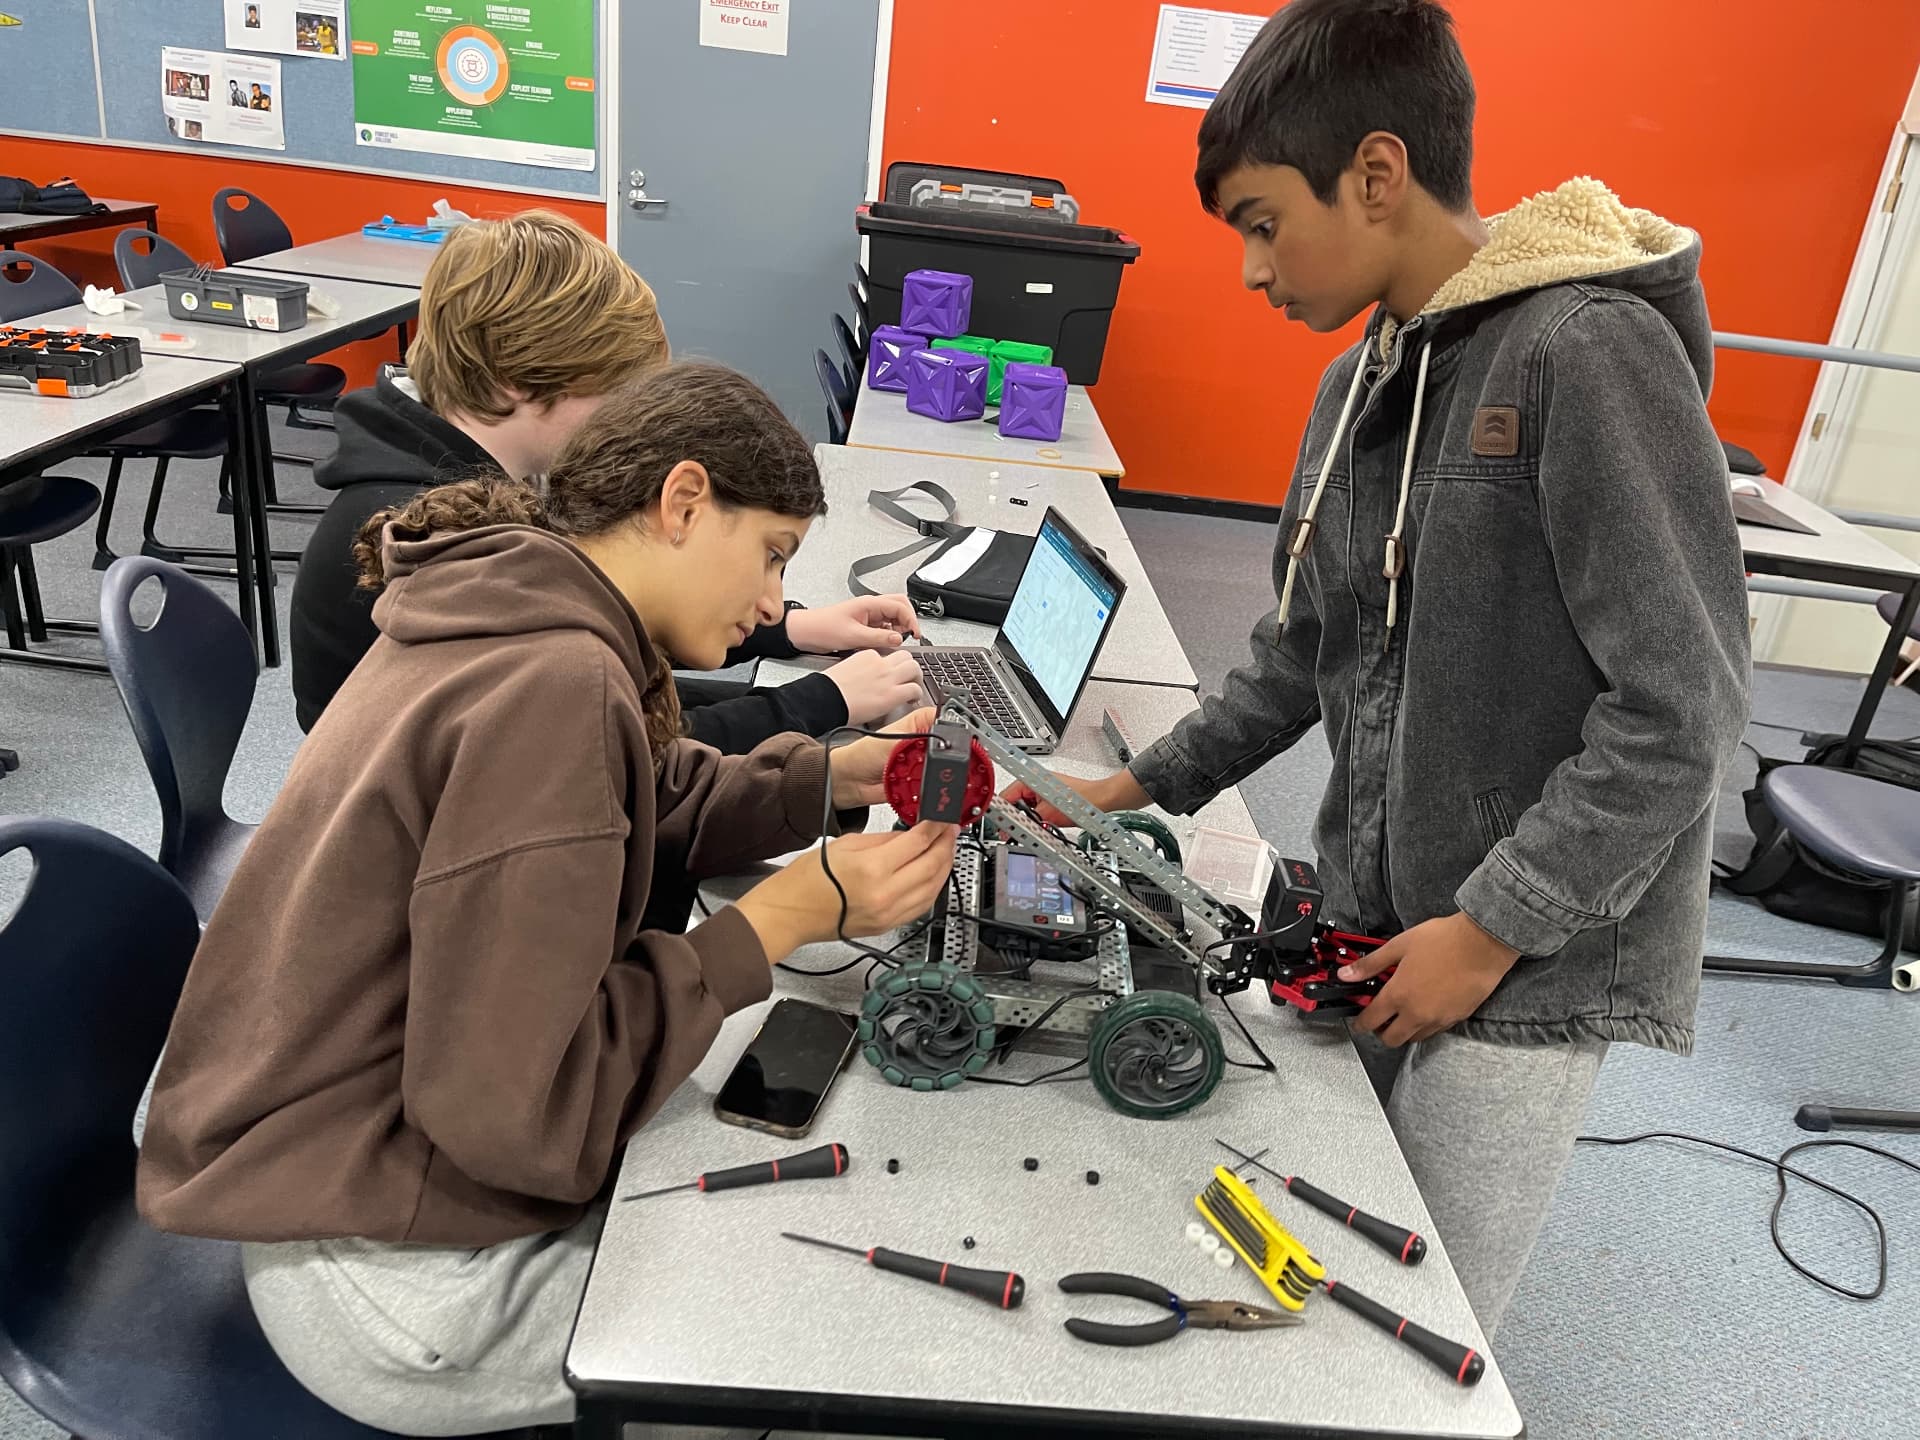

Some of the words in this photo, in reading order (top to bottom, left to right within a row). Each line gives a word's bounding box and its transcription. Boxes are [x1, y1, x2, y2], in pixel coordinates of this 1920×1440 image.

[761, 1, 779, 11] EXIT
[720, 13, 740, 24] KEEP
[742, 16, 768, 28] CLEAR
